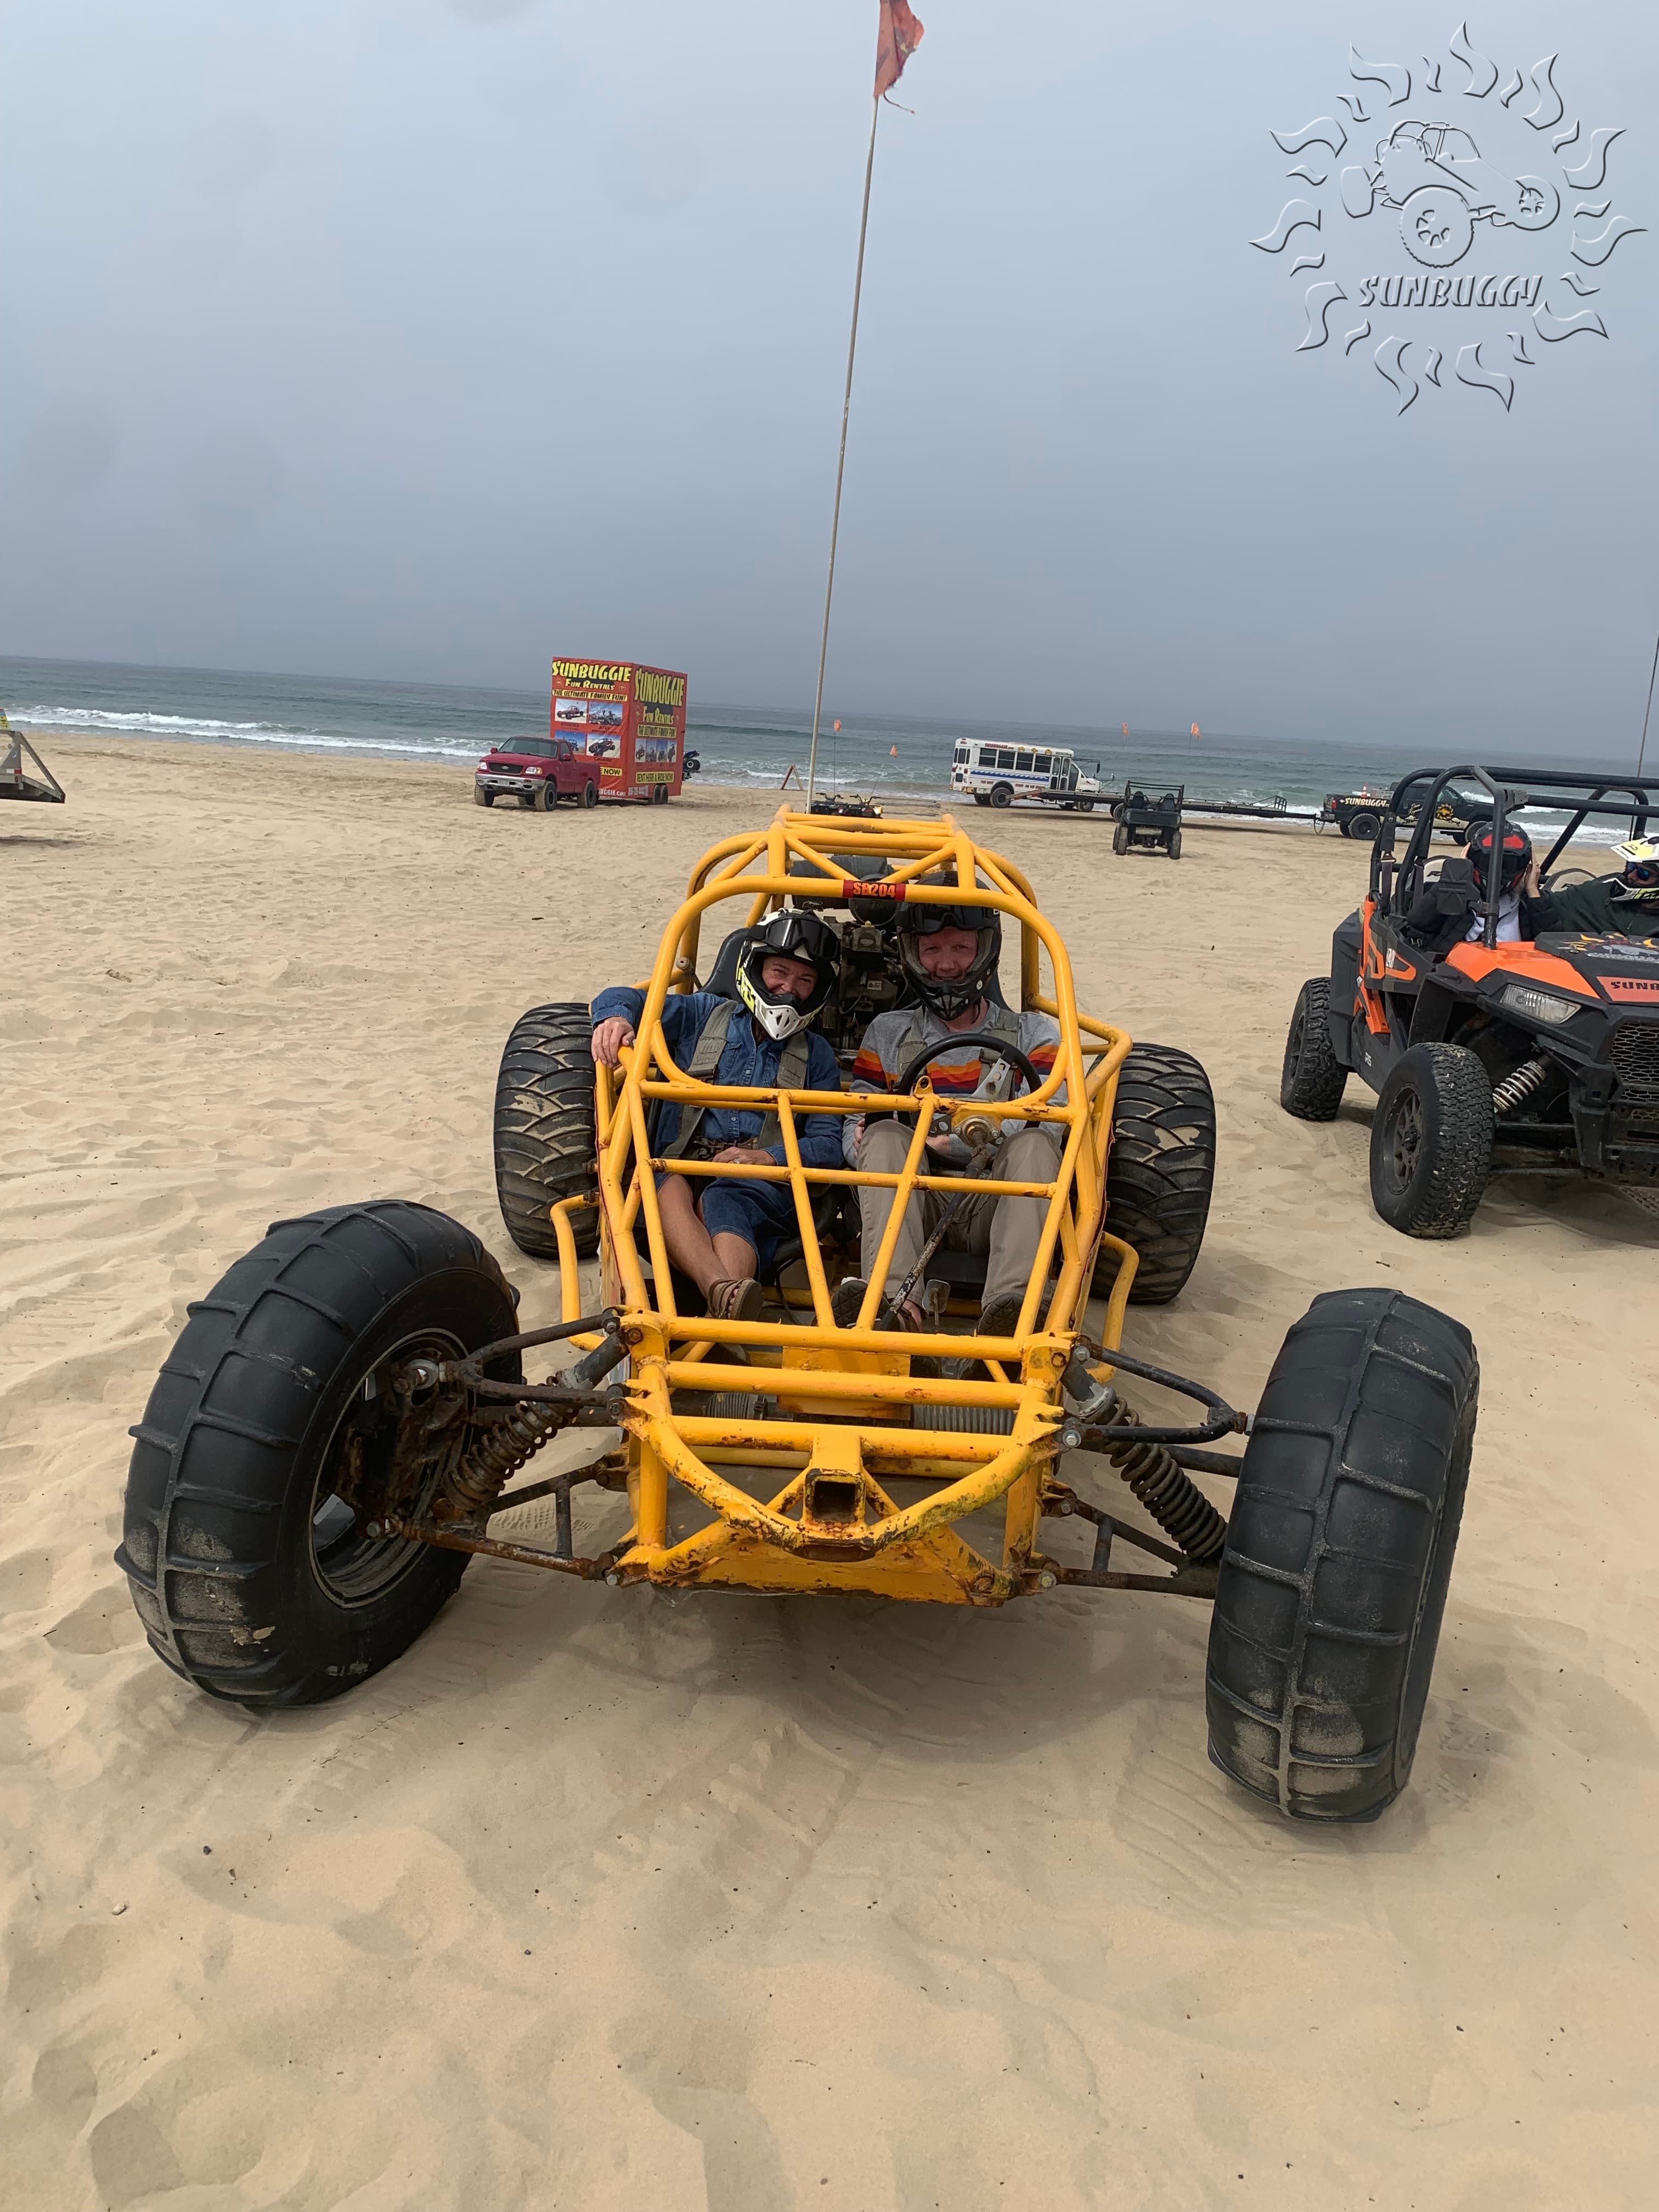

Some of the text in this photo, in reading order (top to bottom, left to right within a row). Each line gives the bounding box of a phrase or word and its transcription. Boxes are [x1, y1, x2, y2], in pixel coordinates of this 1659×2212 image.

[552, 661, 632, 682] SUNBUGGIE
[634, 668, 685, 706] SUNBUGGIE
[853, 882, 895, 898] SB204
